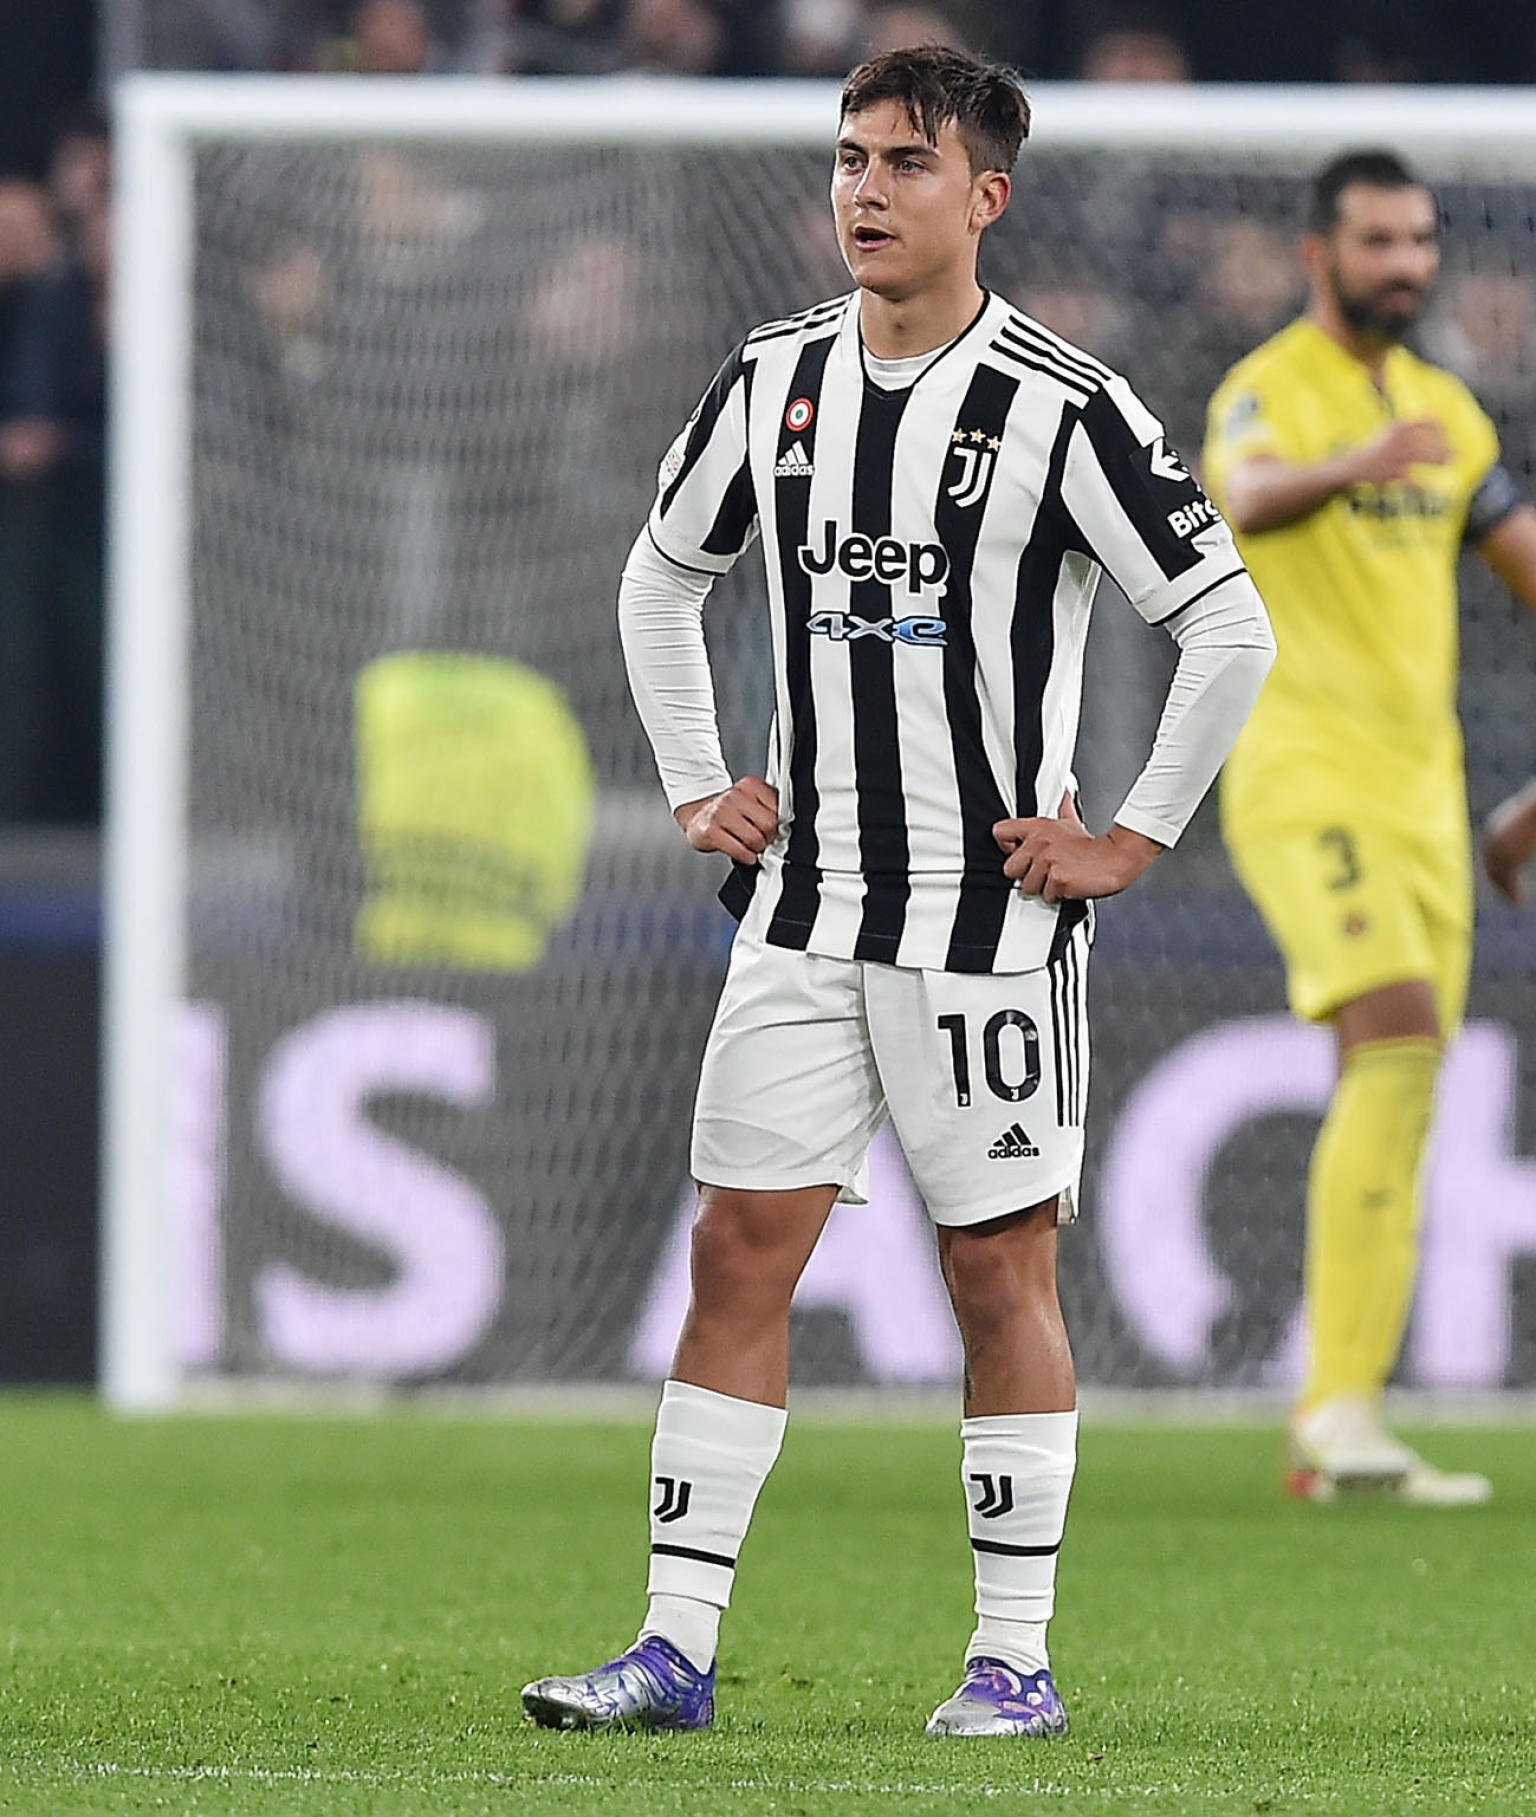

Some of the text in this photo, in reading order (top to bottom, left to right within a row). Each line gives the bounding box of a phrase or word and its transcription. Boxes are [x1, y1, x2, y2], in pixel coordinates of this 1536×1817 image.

[774, 464, 814, 477] adidas
[799, 518, 949, 595] Jeep
[1316, 823, 1361, 892] 3
[937, 1008, 1042, 1108] 10
[987, 1146, 1041, 1160] adidas
